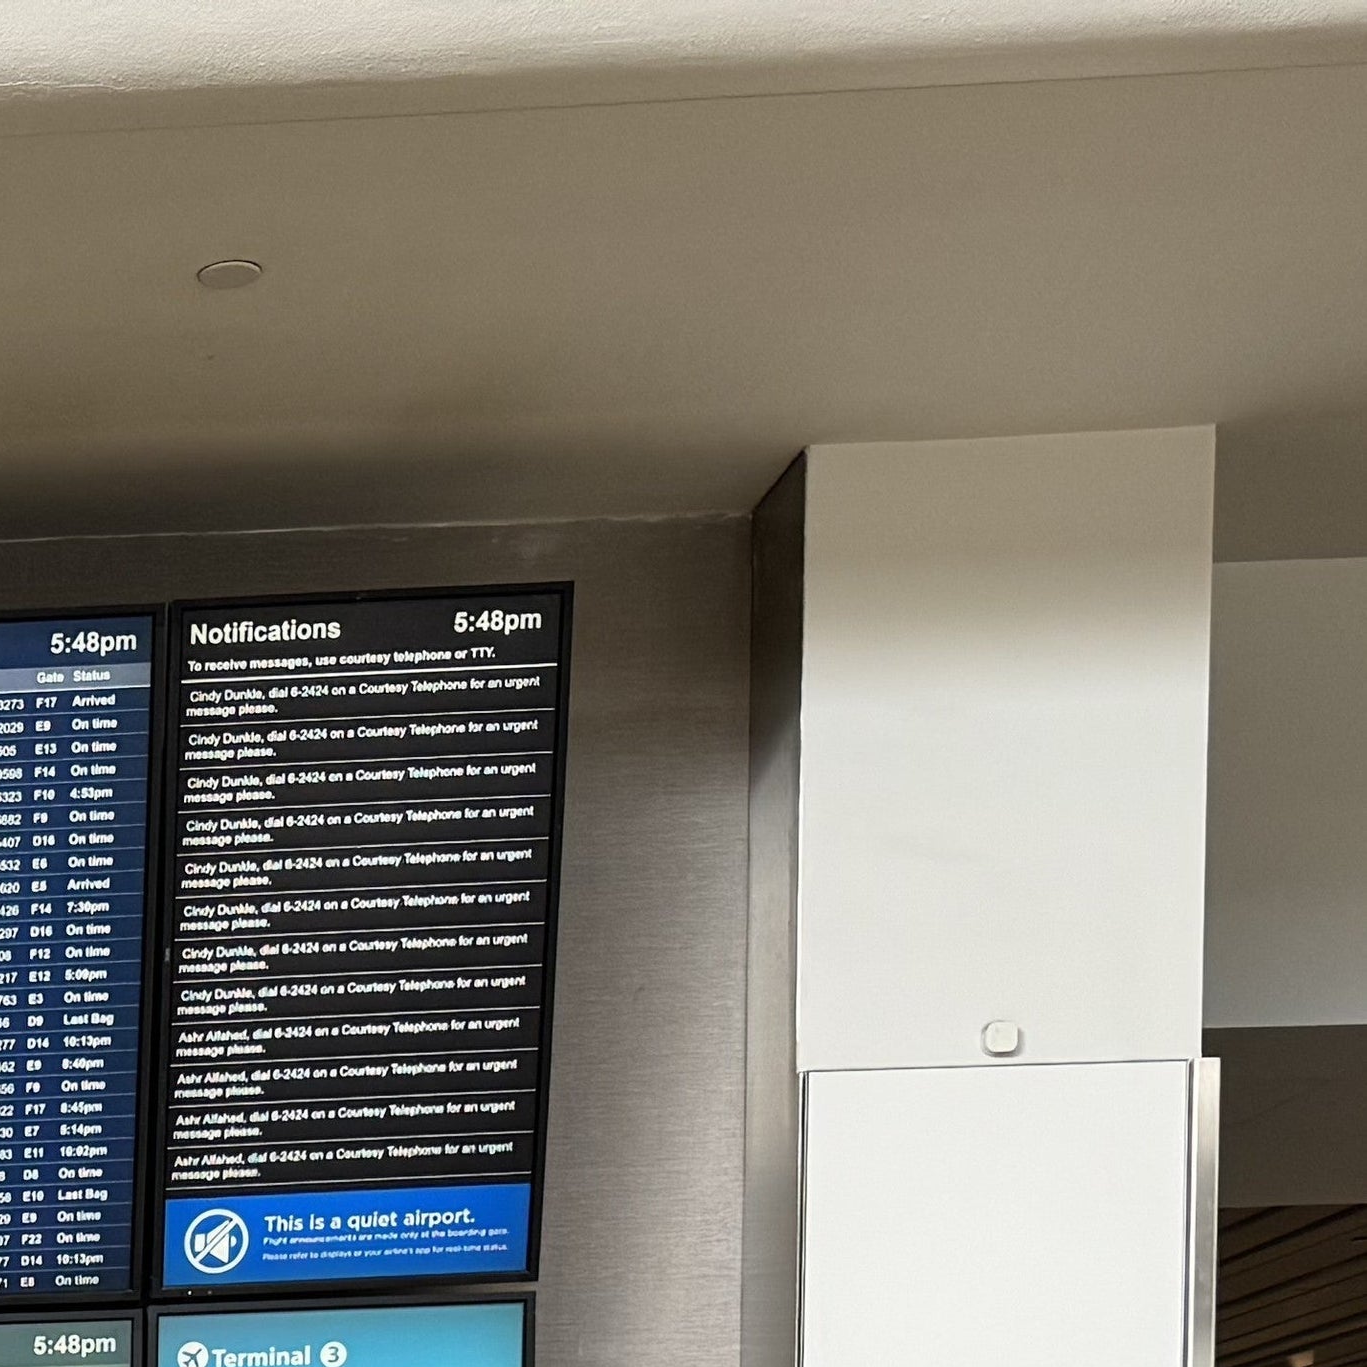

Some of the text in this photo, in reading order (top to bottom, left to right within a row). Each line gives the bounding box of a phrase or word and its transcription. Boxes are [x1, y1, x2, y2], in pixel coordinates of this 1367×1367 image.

[190, 609, 541, 644] Notifications 5:48pm
[50, 631, 136, 656] 5:48pm
[187, 646, 495, 671] To receive messages, use courtesy telephone or TTY.
[36, 671, 64, 683] Gate
[73, 670, 110, 681] Status
[36, 696, 57, 708] F17
[71, 693, 115, 706] Arrived
[190, 676, 539, 703] Cindy Dunkle, dial 6-2424 on a Courtesy Telephone for an urgent
[186, 703, 278, 717] message please.
[264, 1208, 474, 1232] This is a quiet airport.
[33, 1334, 115, 1357] 5:48pm
